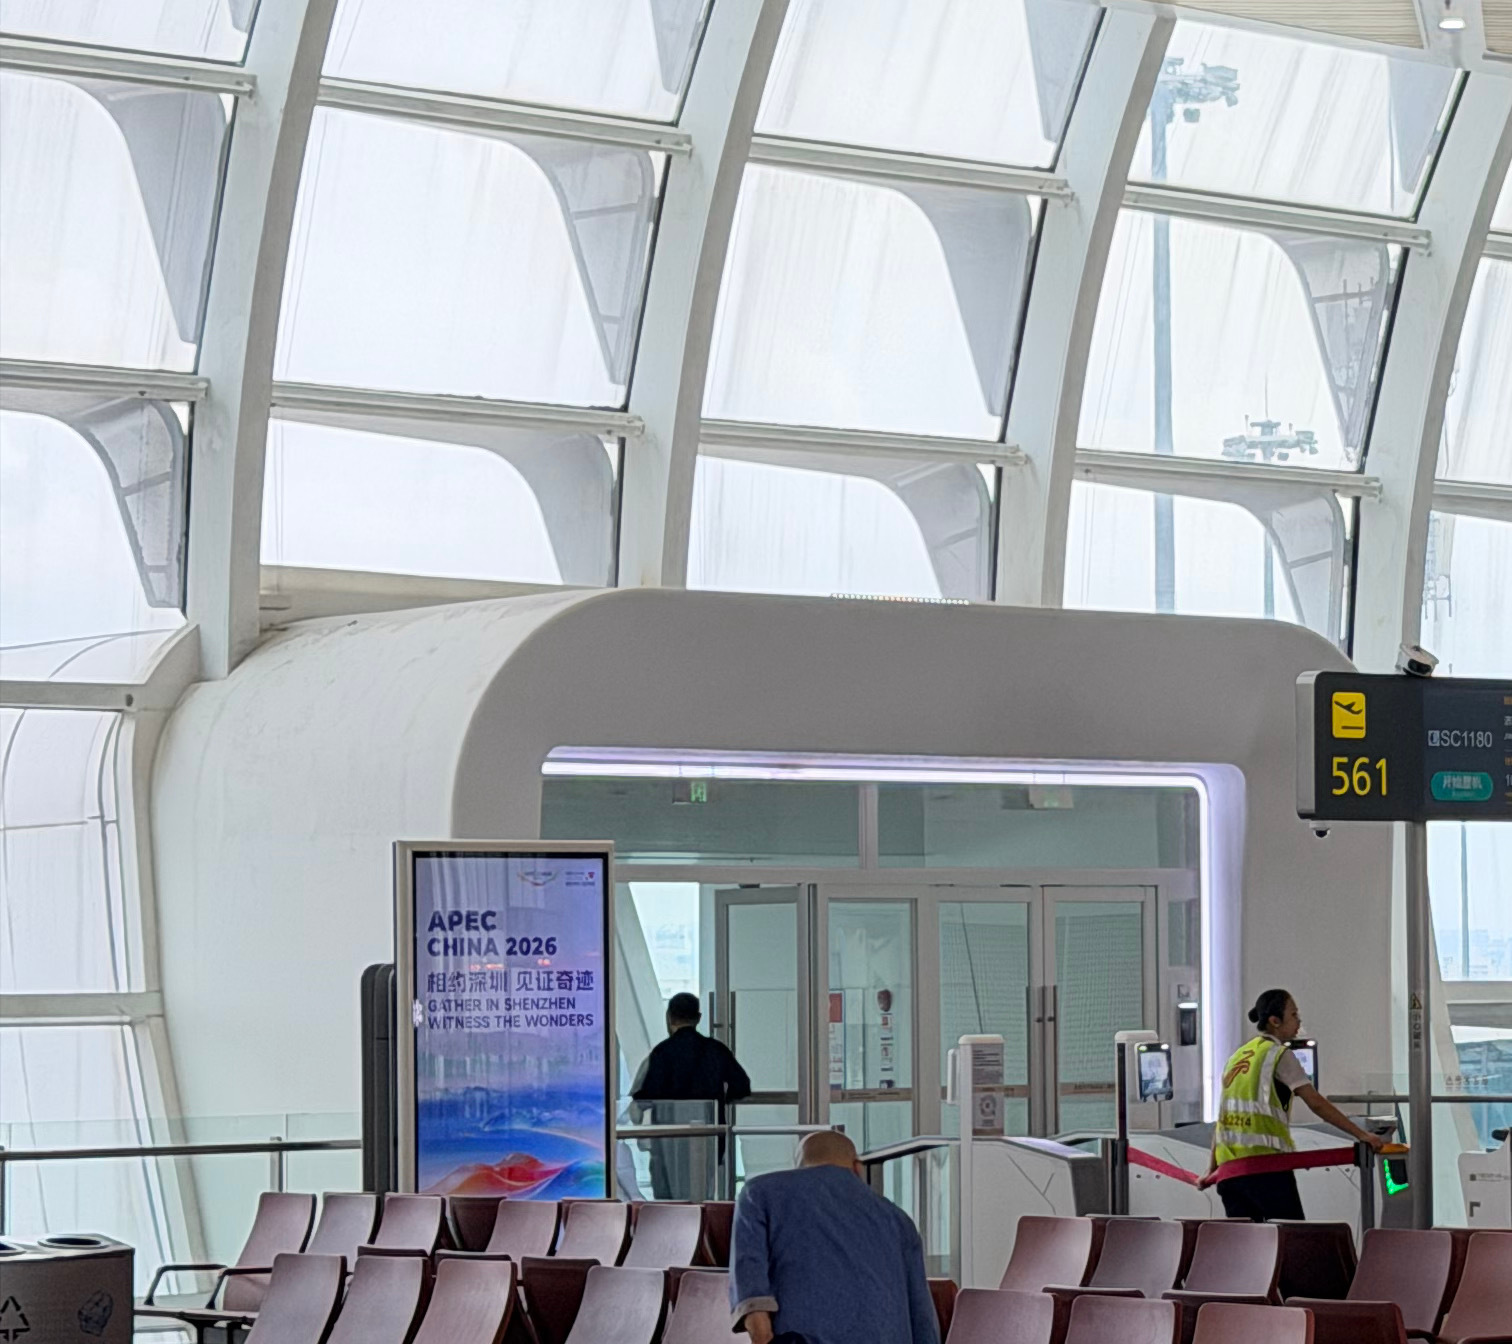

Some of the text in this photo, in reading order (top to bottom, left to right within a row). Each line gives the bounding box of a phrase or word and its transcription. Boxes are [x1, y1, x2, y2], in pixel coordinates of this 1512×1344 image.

[1440, 730, 1493, 748] SC1180
[1331, 756, 1388, 797] 561
[428, 910, 497, 932] APEC
[427, 936, 557, 957] CHINA 2026
[427, 970, 594, 993] 相约深圳 见证奇迹
[428, 997, 576, 1013] GATHER IN SHENZHEN
[428, 1013, 594, 1030] WITNESS THE WONDERS
